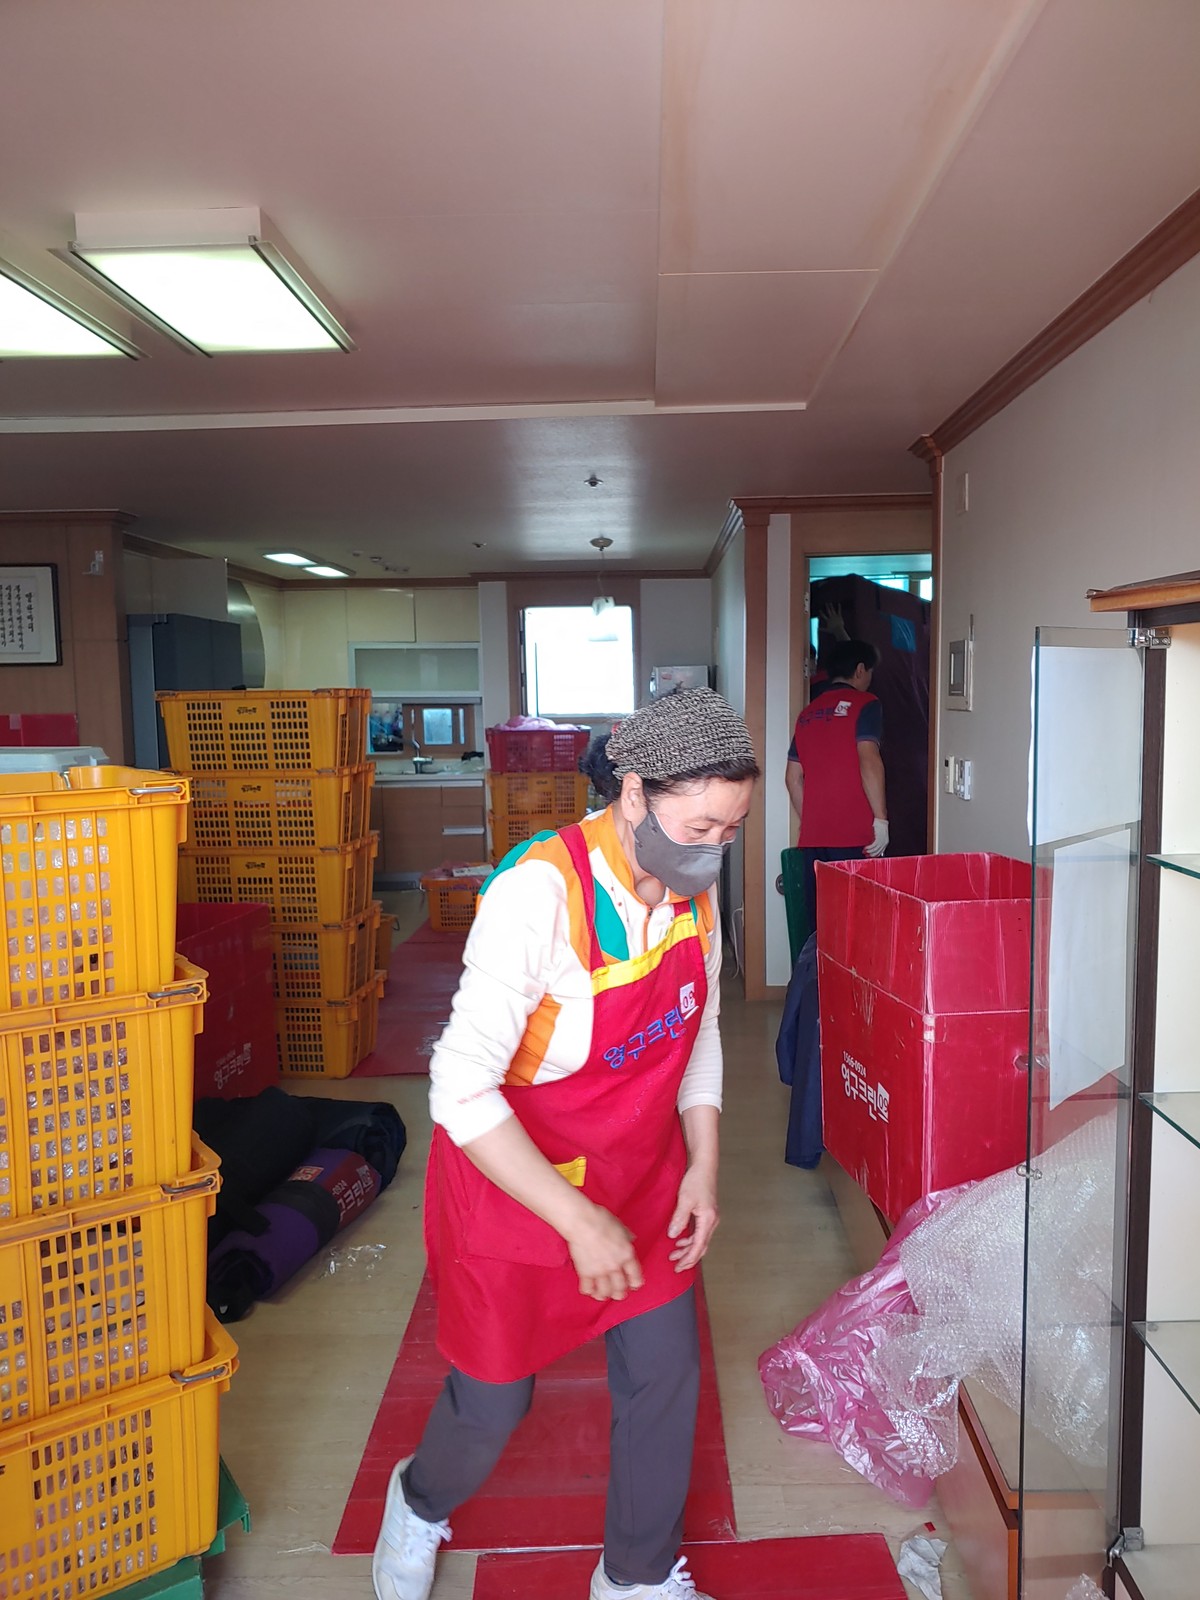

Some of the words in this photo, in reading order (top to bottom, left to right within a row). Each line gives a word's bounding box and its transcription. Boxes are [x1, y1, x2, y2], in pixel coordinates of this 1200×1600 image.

[603, 1005, 687, 1069] 영구크린
[214, 1055, 244, 1090] 영구크린
[843, 1050, 867, 1078] 1566-0924
[841, 1063, 877, 1121] 영구크린
[337, 1180, 365, 1222] 구크린
